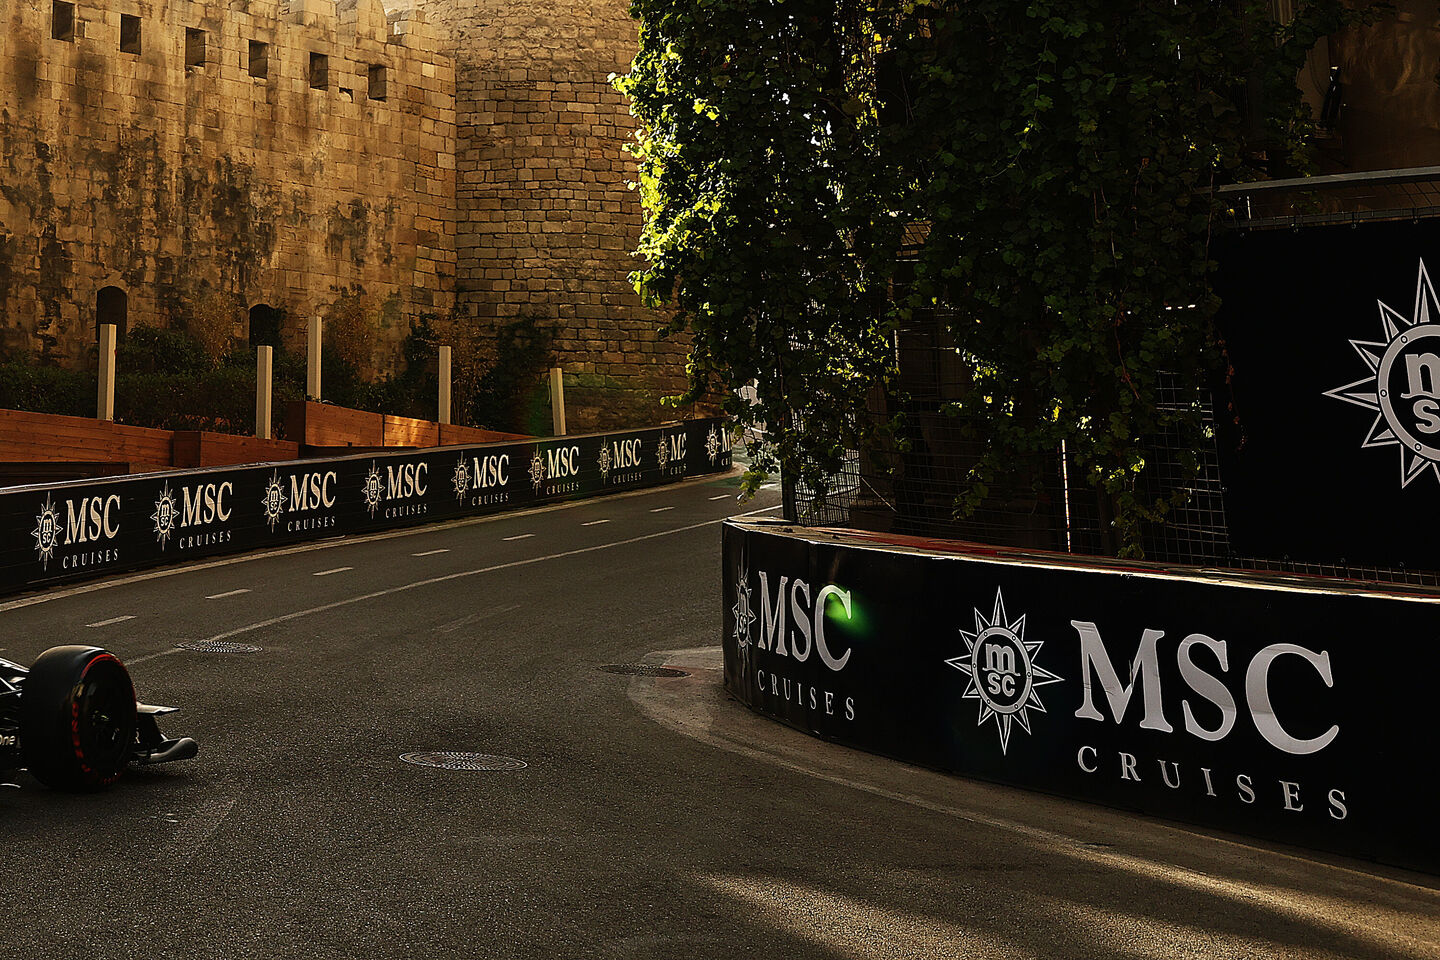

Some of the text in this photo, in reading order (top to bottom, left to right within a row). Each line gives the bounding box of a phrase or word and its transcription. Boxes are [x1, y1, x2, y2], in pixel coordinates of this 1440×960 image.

[547, 445, 579, 479] MSC
[614, 438, 642, 469] MSC
[387, 462, 428, 501] MSC
[473, 454, 509, 489] MSC
[613, 472, 642, 485] CRUISES
[181, 481, 233, 528] MSC
[289, 471, 337, 513] MSC
[472, 493, 509, 507] CRUISES
[546, 482, 579, 496] CRUISES
[64, 494, 121, 545] MSC
[287, 515, 336, 532] CRUISES
[385, 503, 427, 519] CRUISES
[180, 530, 232, 549] CRUISES
[62, 548, 120, 569] CRUISES
[758, 571, 852, 672] MSC
[758, 669, 855, 721] CRUISES
[1071, 620, 1340, 755] MSC
[1077, 746, 1349, 821] CRUISES
